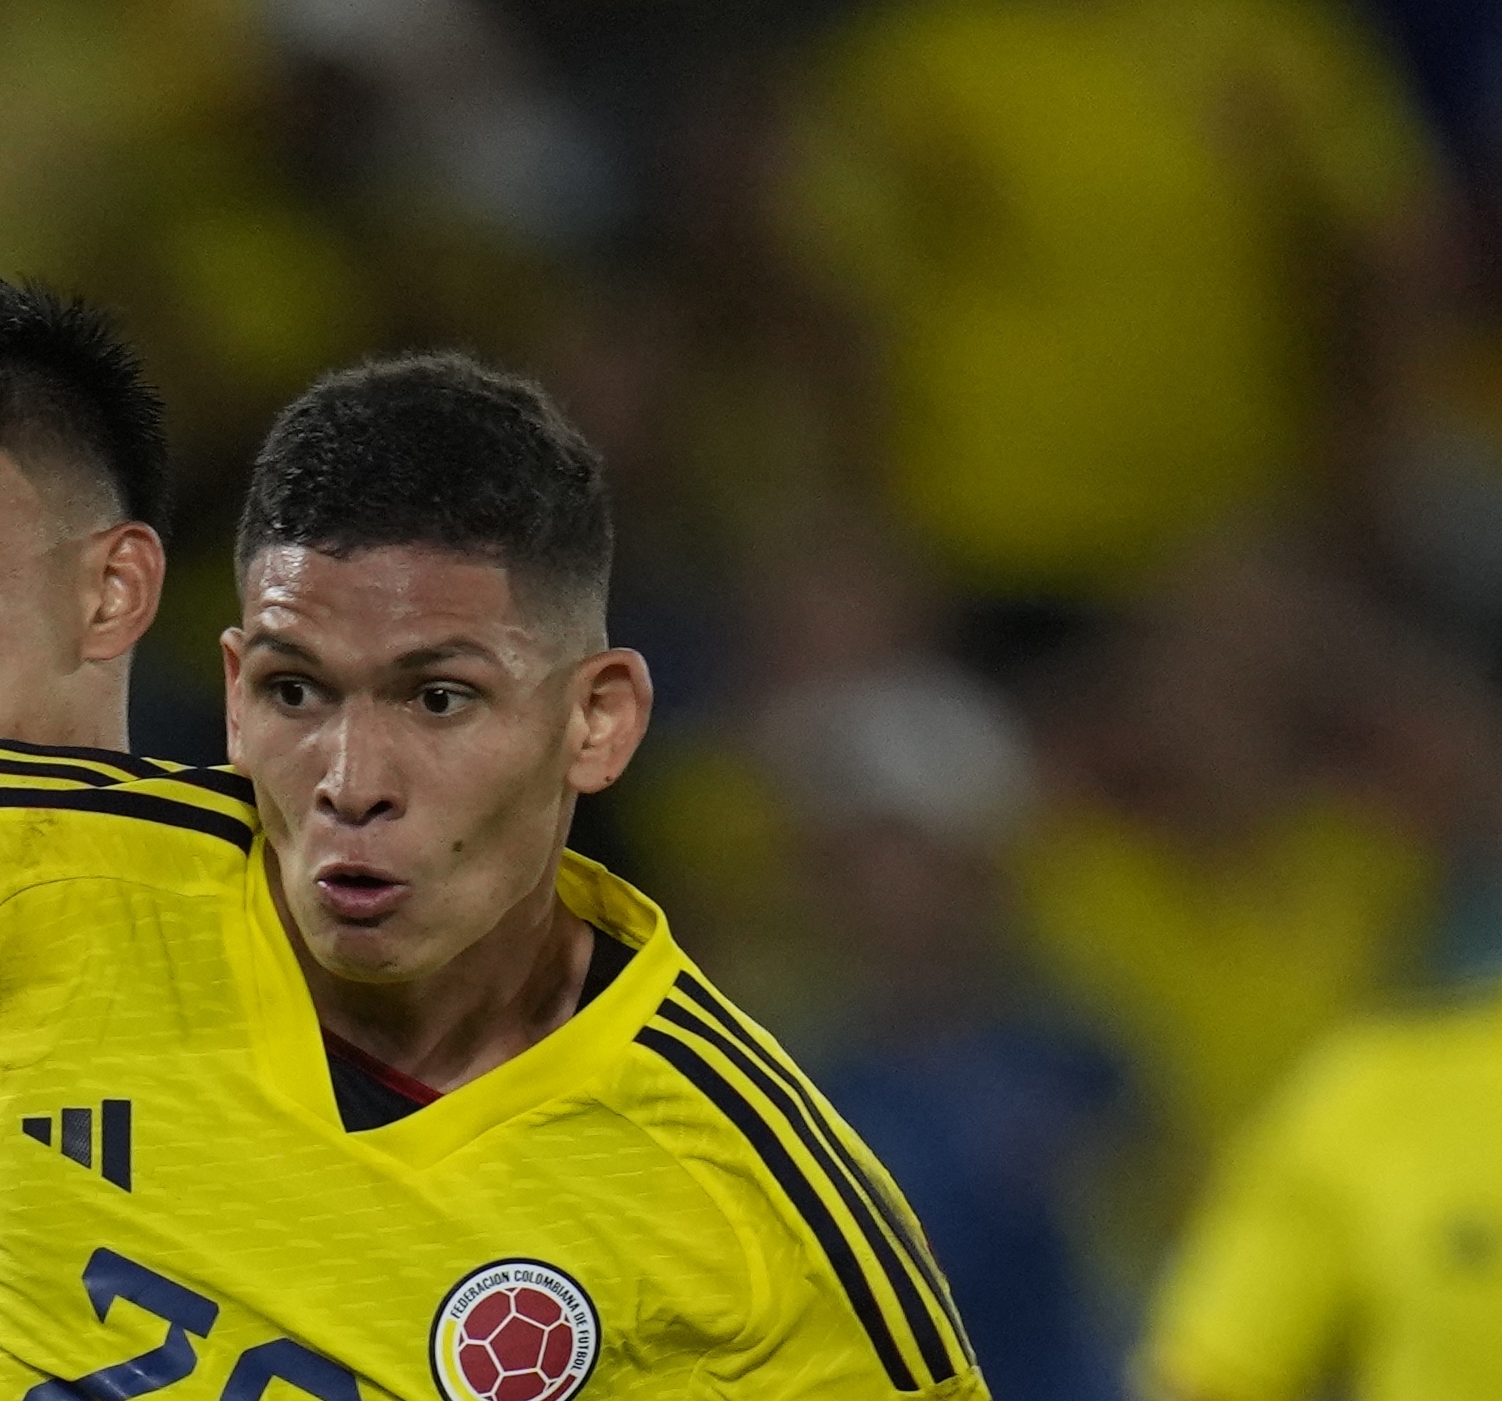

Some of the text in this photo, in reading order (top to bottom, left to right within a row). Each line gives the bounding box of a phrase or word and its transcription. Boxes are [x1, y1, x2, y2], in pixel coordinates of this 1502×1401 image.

[450, 1269, 590, 1371] FEDERACION COLOMBIANA DE FUTBOL
